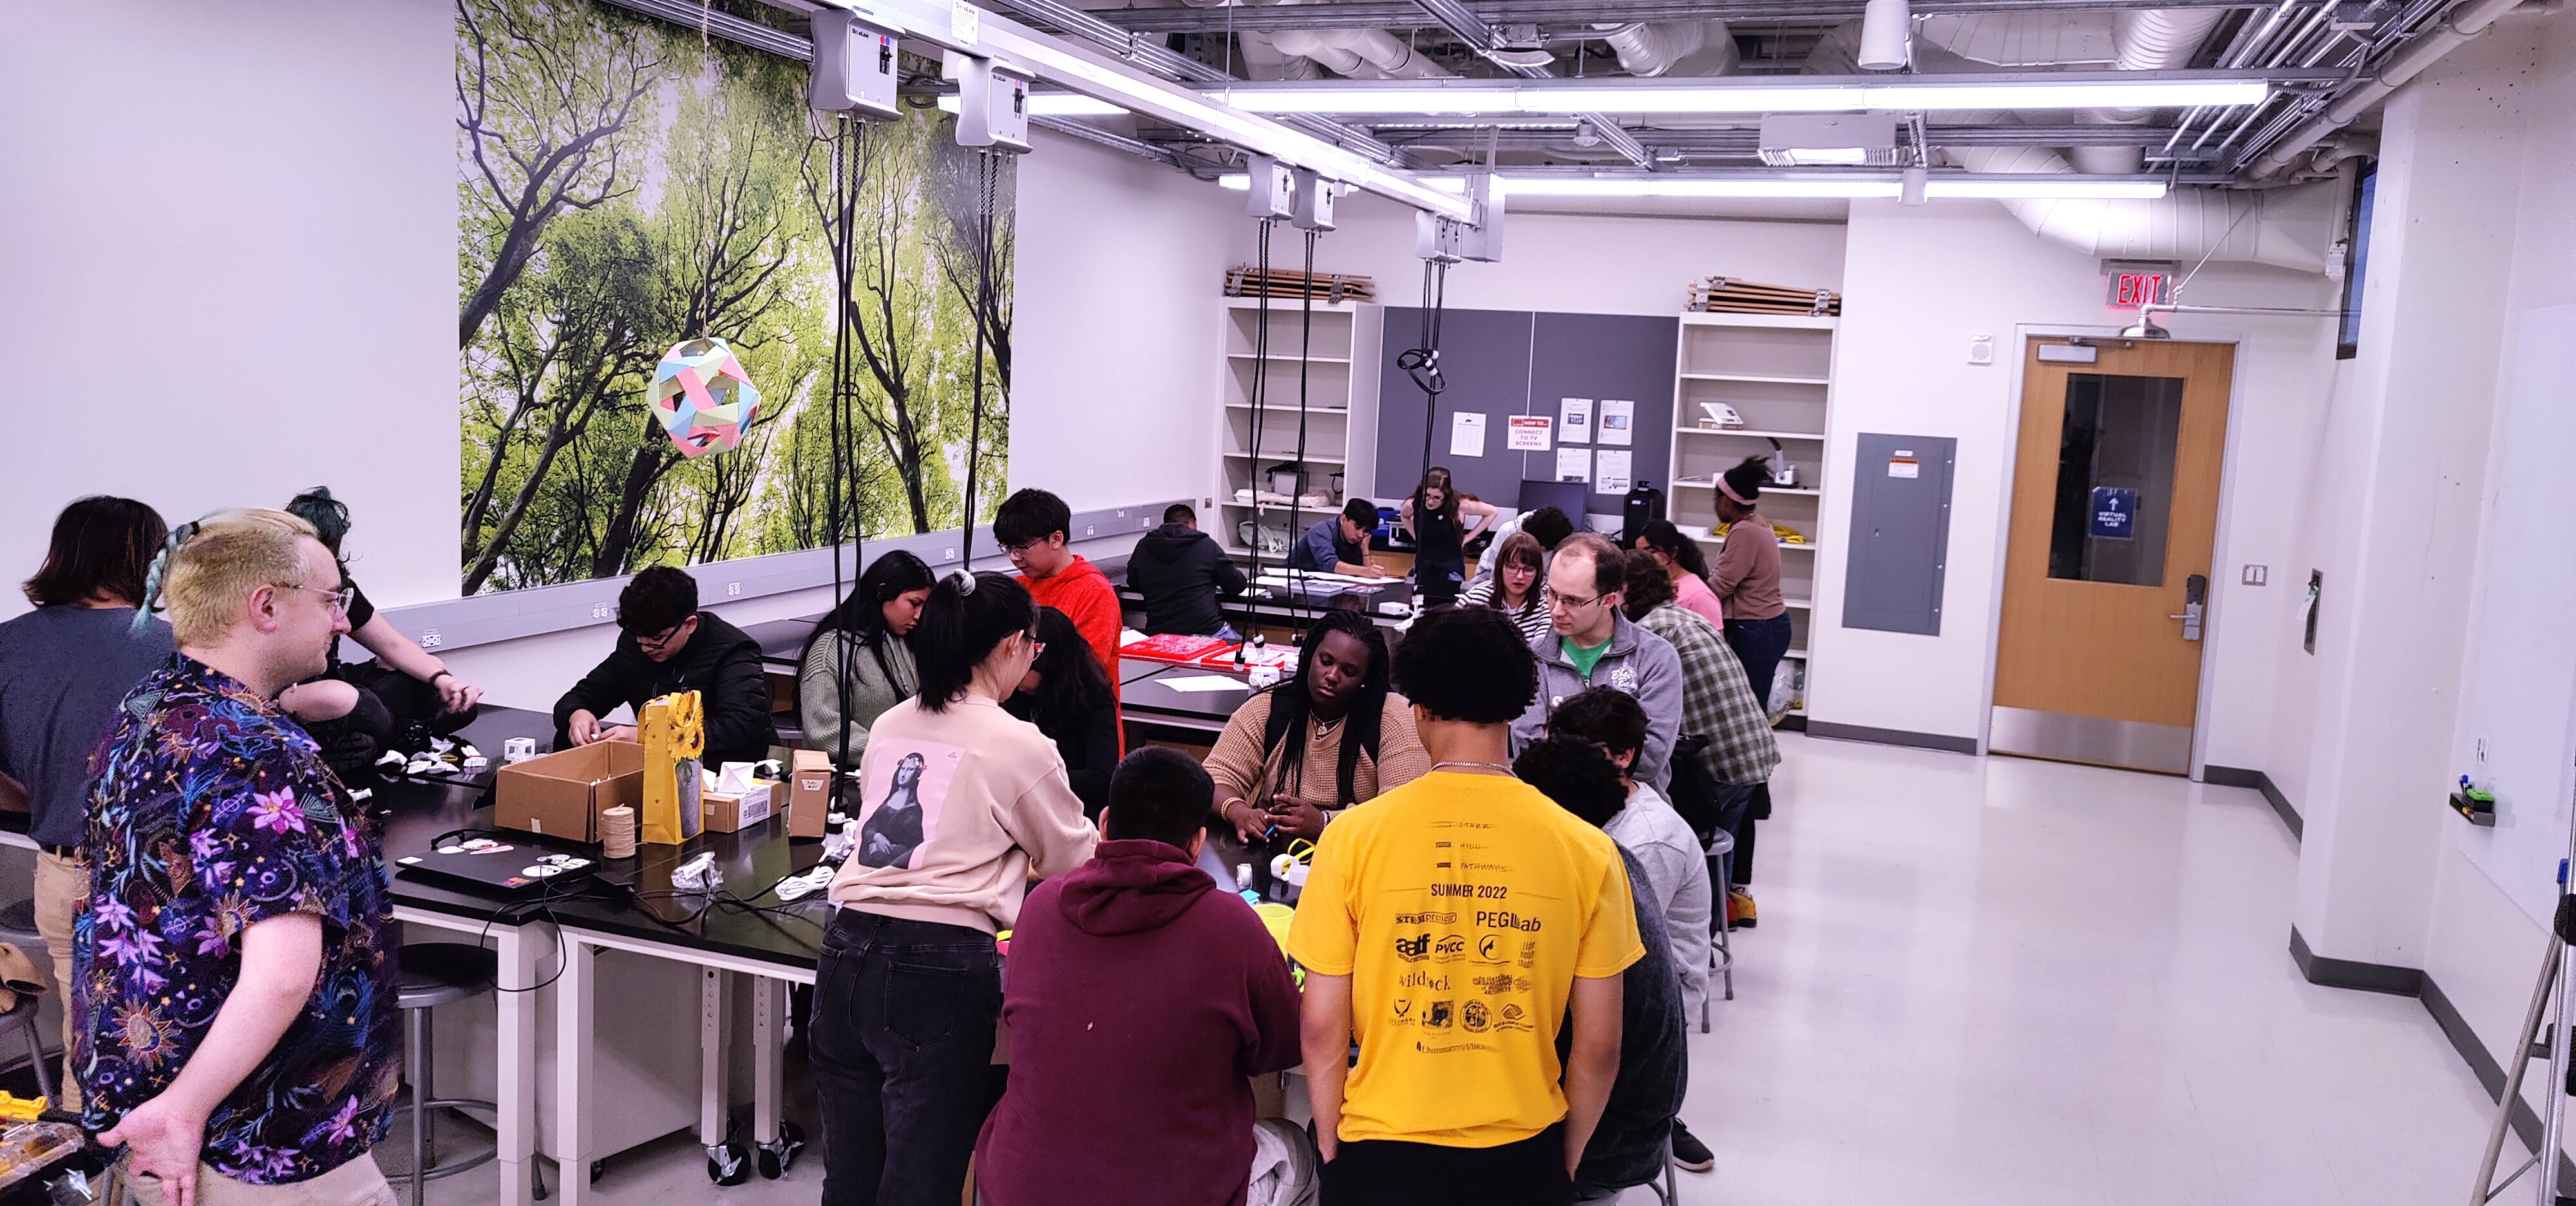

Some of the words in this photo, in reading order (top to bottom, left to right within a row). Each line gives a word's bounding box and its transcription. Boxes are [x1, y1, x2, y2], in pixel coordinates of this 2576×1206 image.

[2117, 274, 2163, 304] EXIT
[1431, 883, 1473, 898] SUMMER
[1477, 885, 1508, 899] 2022
[1435, 941, 1465, 954] PVCC
